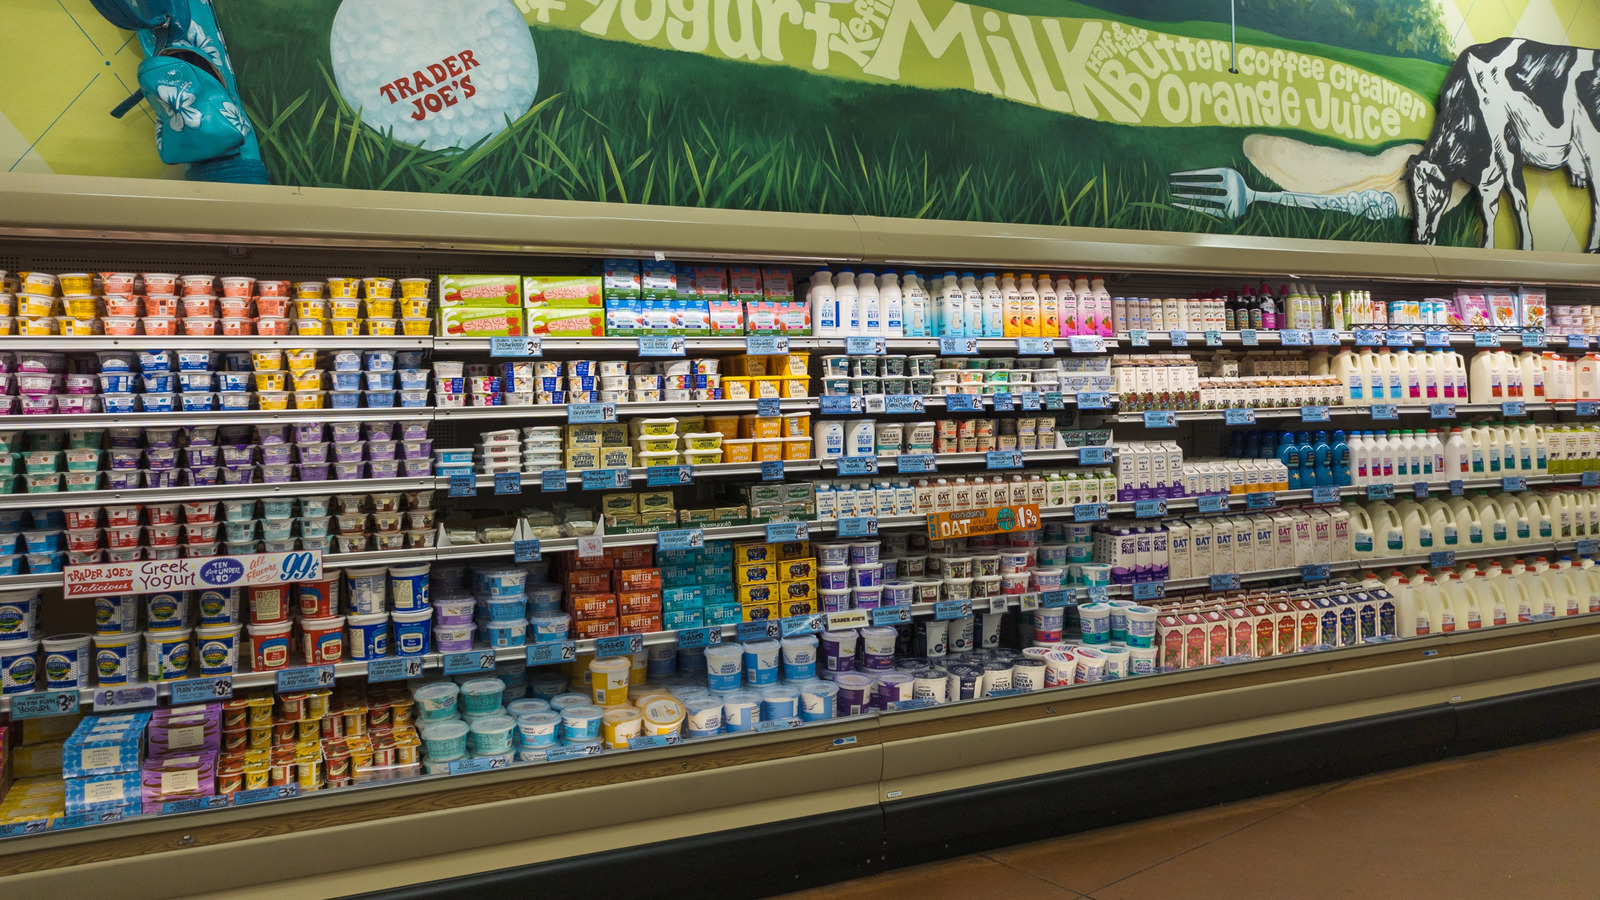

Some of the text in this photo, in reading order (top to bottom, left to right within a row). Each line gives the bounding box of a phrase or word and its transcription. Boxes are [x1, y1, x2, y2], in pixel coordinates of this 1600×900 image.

[1115, 29, 1149, 57] Half
[1087, 38, 1115, 75] Half
[380, 50, 481, 105] TRADER
[1084, 36, 1230, 123] Butter
[411, 74, 476, 121] JOE'S
[1158, 72, 1402, 141] Orange Juice
[937, 493, 950, 501] OAT
[956, 492, 970, 500] OAT
[975, 491, 988, 499] OAT
[994, 490, 1007, 498] OAT
[1031, 488, 1044, 496] OAT
[941, 518, 971, 538] OAT
[1296, 523, 1309, 532] OAT
[1315, 523, 1329, 532] OAT
[1335, 522, 1347, 531] OAT
[1237, 532, 1252, 542] OAT
[1257, 530, 1272, 540] OAT
[1278, 528, 1291, 537] OAT
[1173, 538, 1188, 548] OAT
[1195, 536, 1211, 546] OAT
[1217, 534, 1232, 544] OAT
[140, 559, 189, 575] Greek
[67, 567, 134, 583] TRADER JOE'S
[630, 573, 652, 583] BUTTER
[139, 571, 196, 590] Yogurt
[578, 576, 600, 585] BUTTER
[73, 582, 128, 593] Delicious
[630, 596, 651, 605] BUTTER
[673, 592, 694, 602] BUTTER
[584, 601, 607, 611] BUTTER
[674, 613, 694, 623] BUTTER
[713, 609, 734, 619] BUTTER
[630, 617, 652, 627] BUTTER
[587, 623, 609, 633] BUTTER
